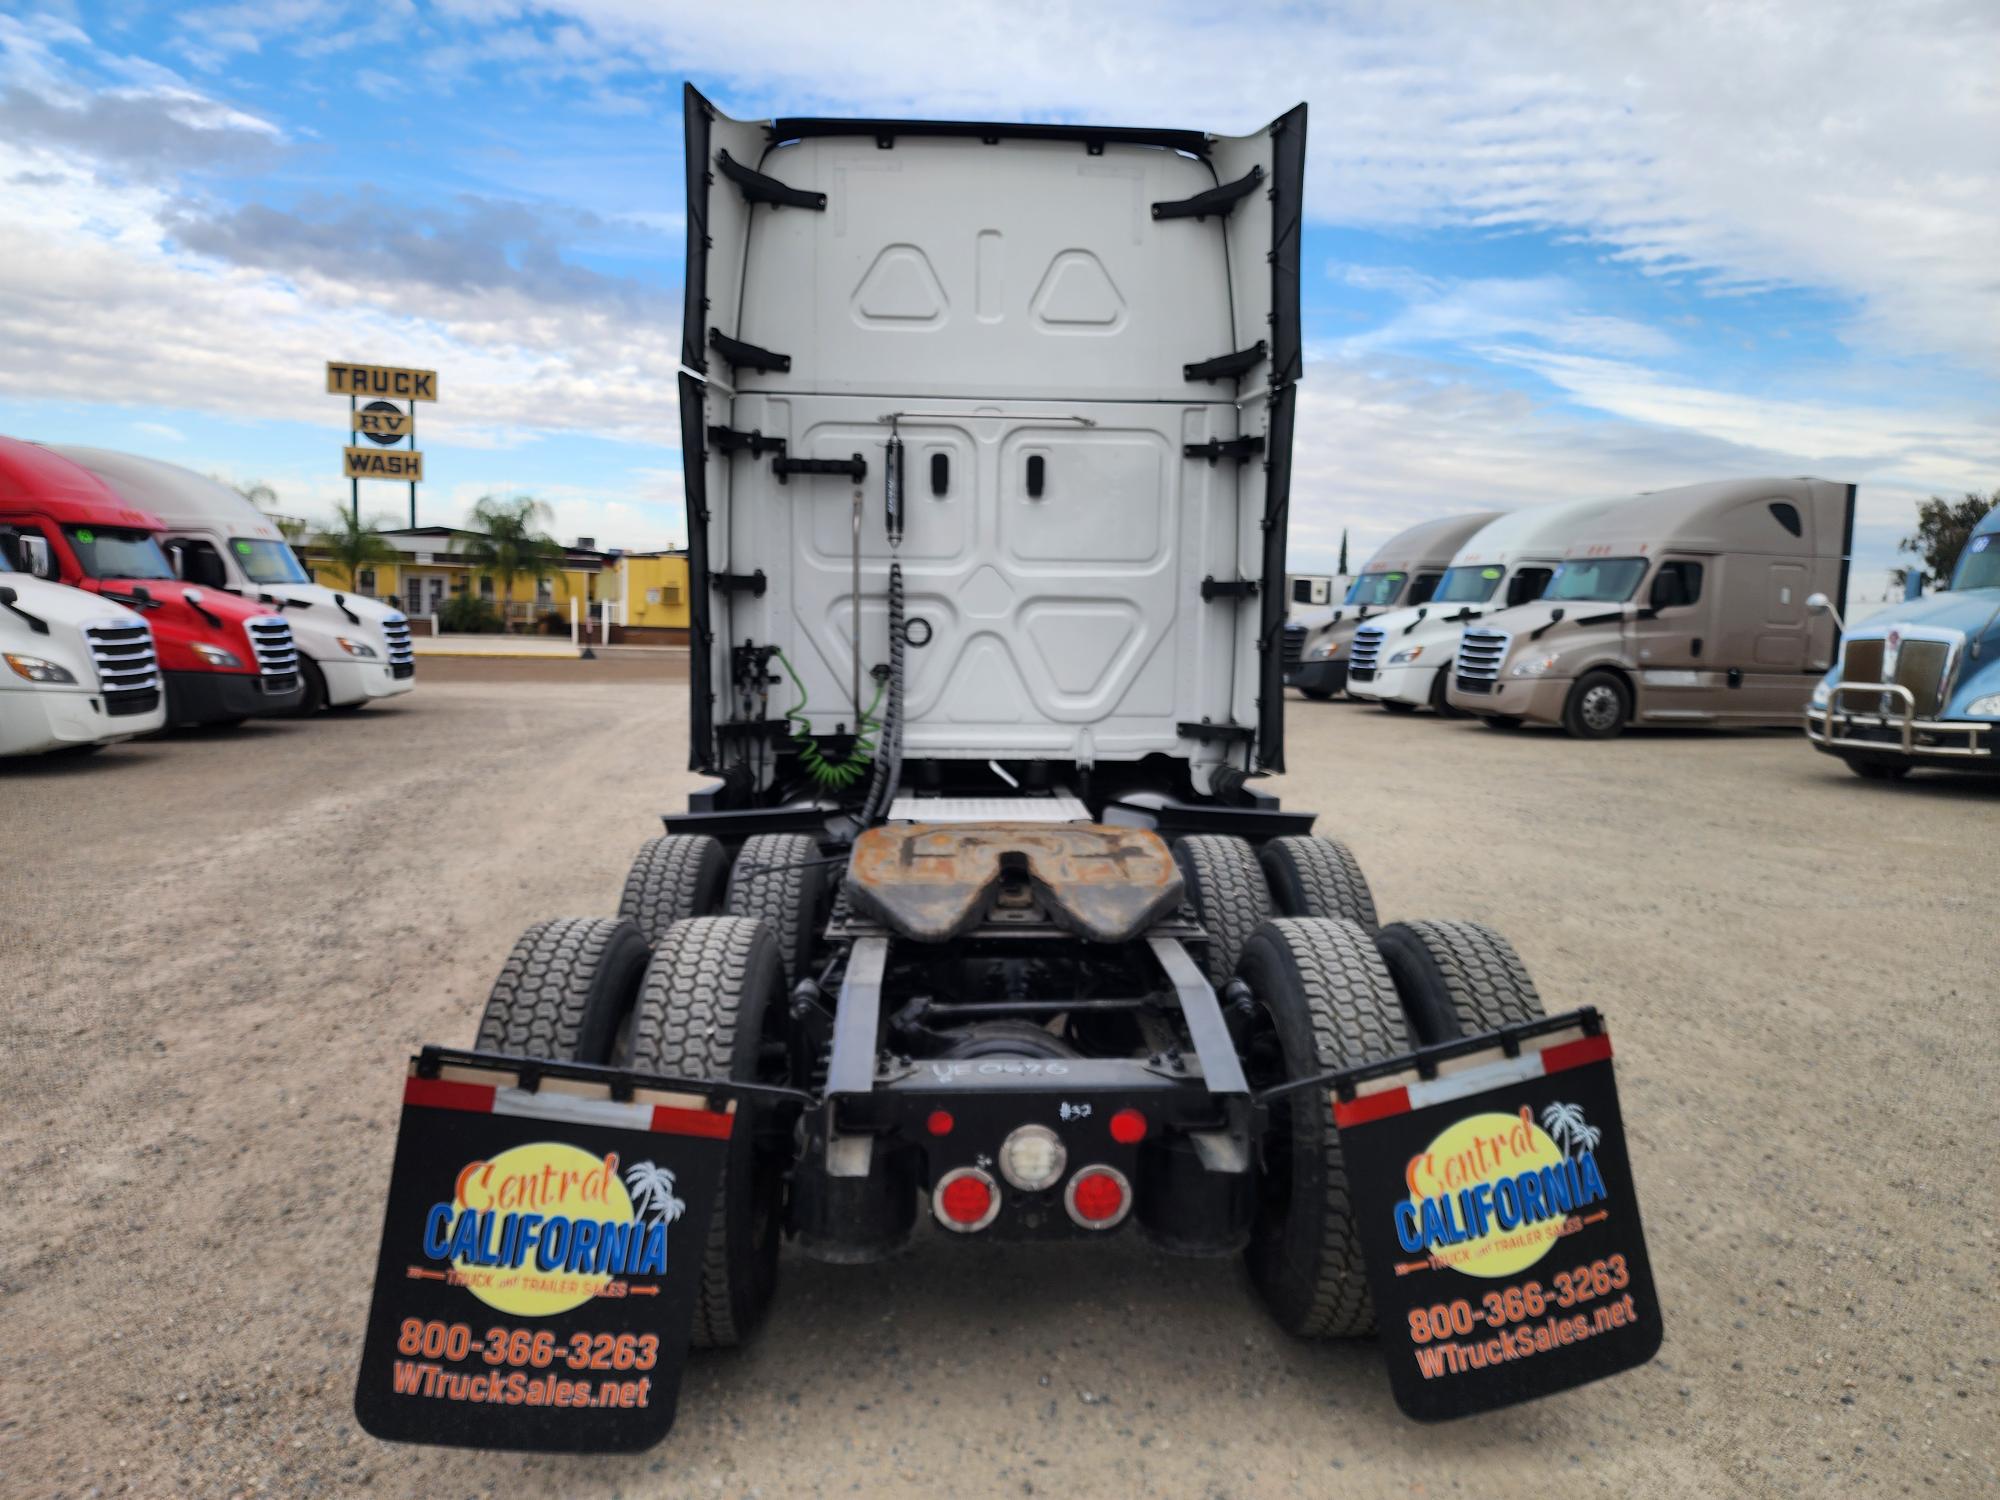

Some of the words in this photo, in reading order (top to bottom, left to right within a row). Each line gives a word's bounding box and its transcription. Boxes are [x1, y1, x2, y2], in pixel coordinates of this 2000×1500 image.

[330, 367, 431, 397] TRUCK
[360, 414, 404, 431] RV
[347, 453, 419, 475] WASH
[1406, 1105, 1538, 1200] Central
[455, 1152, 619, 1214] Central
[1393, 1153, 1608, 1254] CALIFORNIA
[423, 1202, 668, 1276] CALIFORNIA
[1427, 1248, 1472, 1271] TRUCK
[1495, 1230, 1543, 1252] TRAILER
[1546, 1215, 1584, 1238] SALES
[446, 1268, 495, 1288] TRUCK
[521, 1276, 580, 1295] TRAILER
[582, 1280, 628, 1298] SALES
[1408, 1253, 1630, 1344] 800-366-3263
[397, 1316, 659, 1371] 800-366-3263
[1415, 1293, 1638, 1380] WTruckSales.net
[393, 1358, 652, 1409] WTruckSales.net
